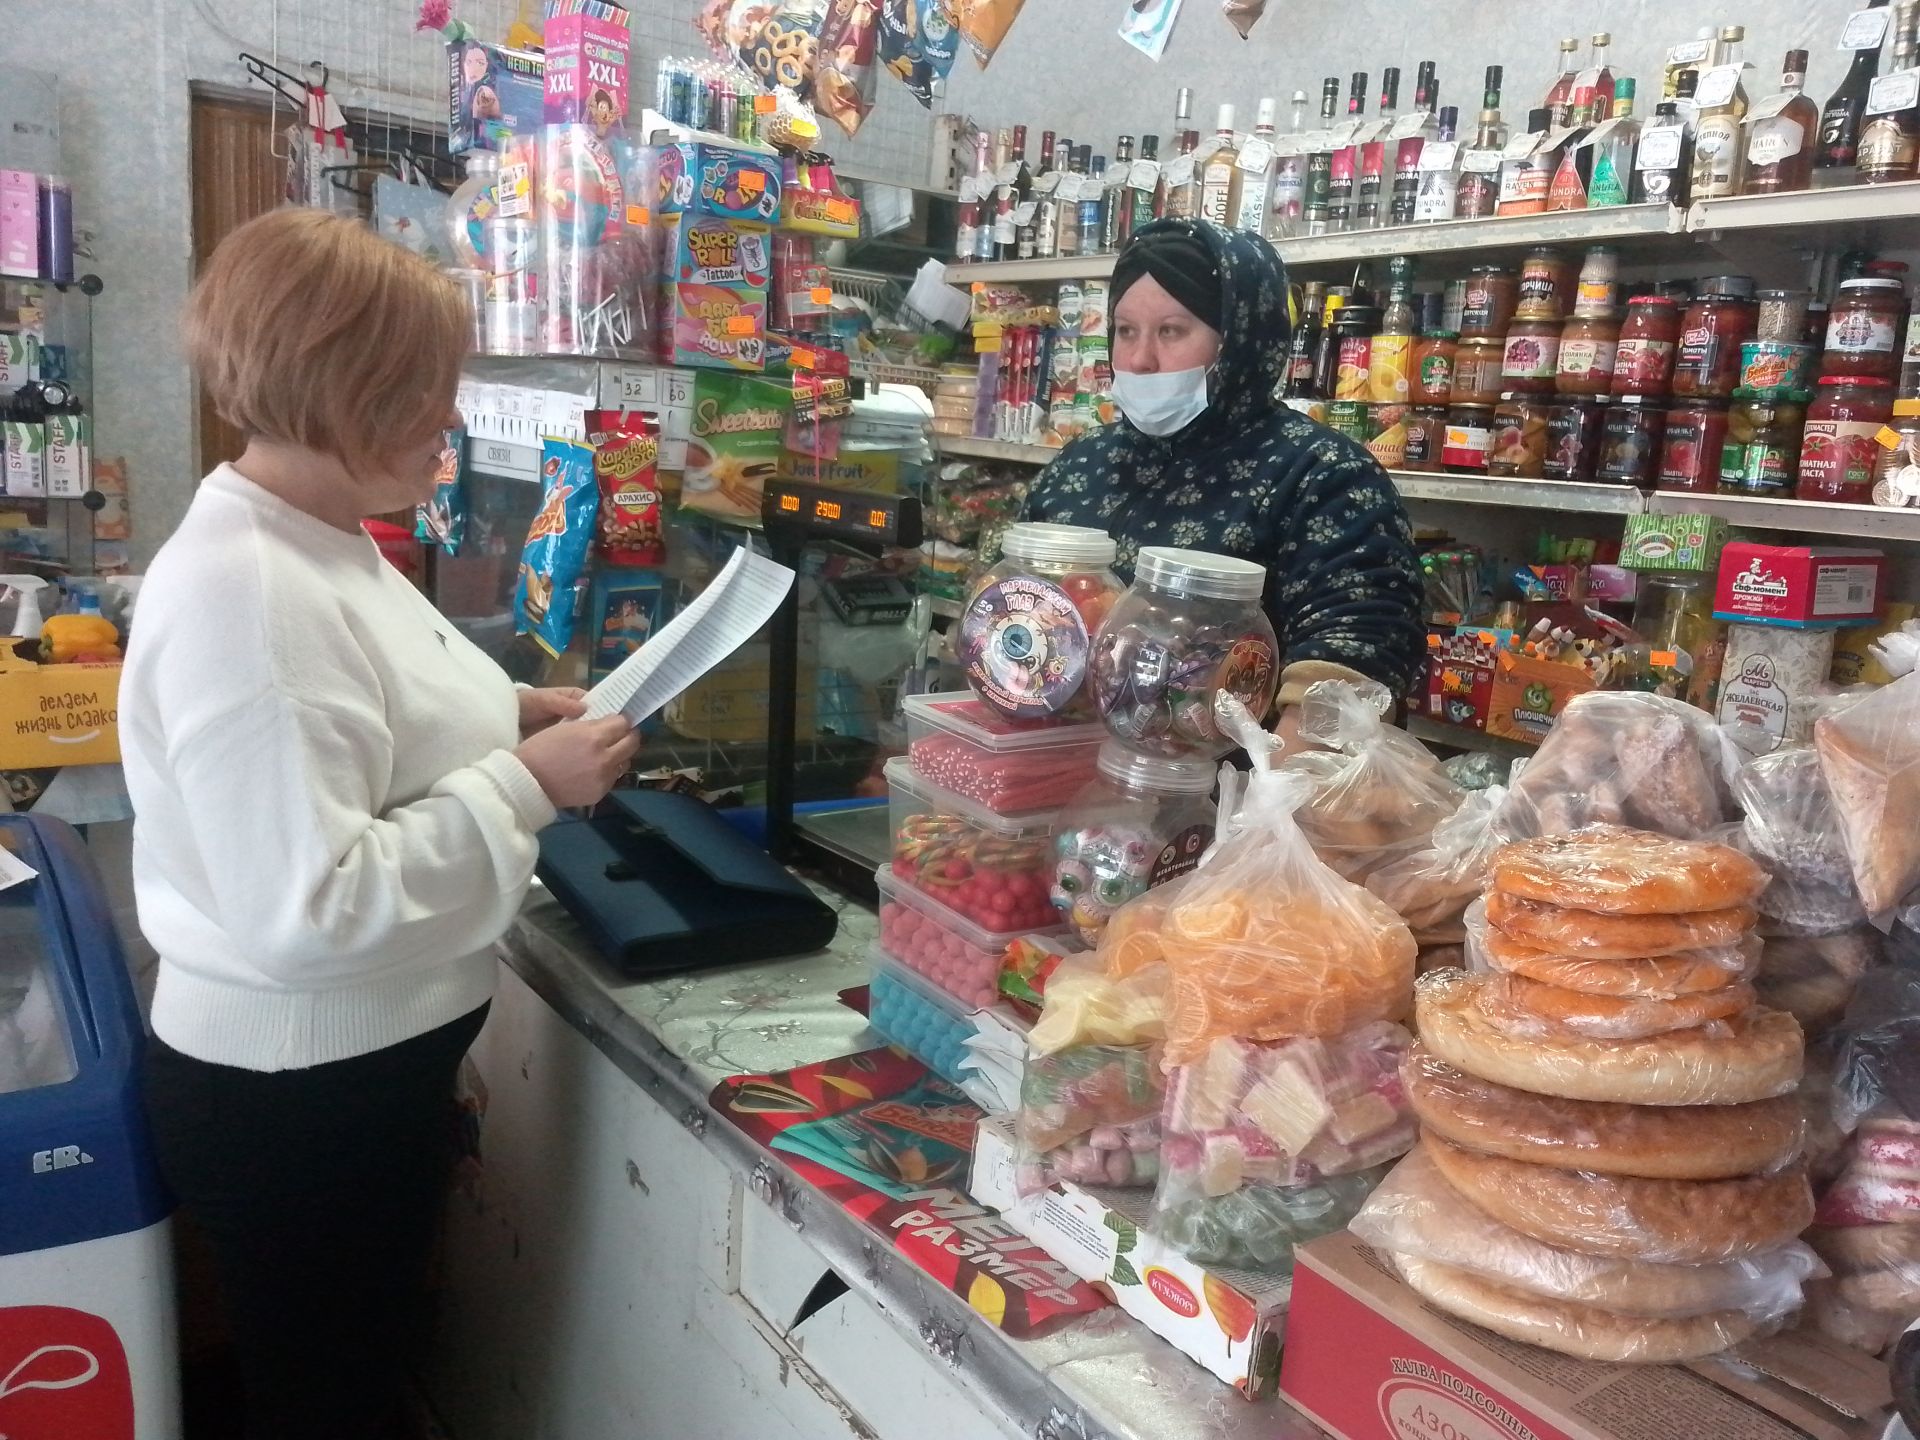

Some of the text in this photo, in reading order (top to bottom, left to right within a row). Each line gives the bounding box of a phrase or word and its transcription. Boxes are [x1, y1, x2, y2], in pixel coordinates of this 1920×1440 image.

[549, 73, 574, 94] XXL
[587, 60, 621, 87] XXL
[1504, 180, 1535, 191] RAVEN
[687, 226, 739, 250] SUPER
[694, 248, 737, 267] ROLL
[704, 267, 737, 281] Tattoo
[1520, 279, 1554, 293] ОРЧИЦА
[699, 332, 735, 354] ROLL
[624, 382, 642, 396] 32
[823, 382, 844, 393] АВТО
[10, 432, 22, 470] STAFF
[52, 422, 66, 465] STAFF
[829, 461, 864, 480] Fruit
[617, 492, 653, 503] АРАХИС
[978, 599, 994, 612] 50
[1005, 593, 1035, 612] ГЛАЗ
[1733, 593, 1764, 602] ДРОЖЖИ
[1743, 677, 1770, 688] МАРТИН
[39, 692, 98, 713] делаем
[1725, 693, 1784, 714] ЖЕЛАЕВСКАЯ
[15, 715, 62, 735] жизнь
[900, 1188, 1082, 1291] МЕГА
[890, 1210, 1079, 1306] РАЗМЕР
[1151, 1278, 1195, 1315] АЗОВСКАЯ
[1391, 1357, 1439, 1383] ХАЛВА
